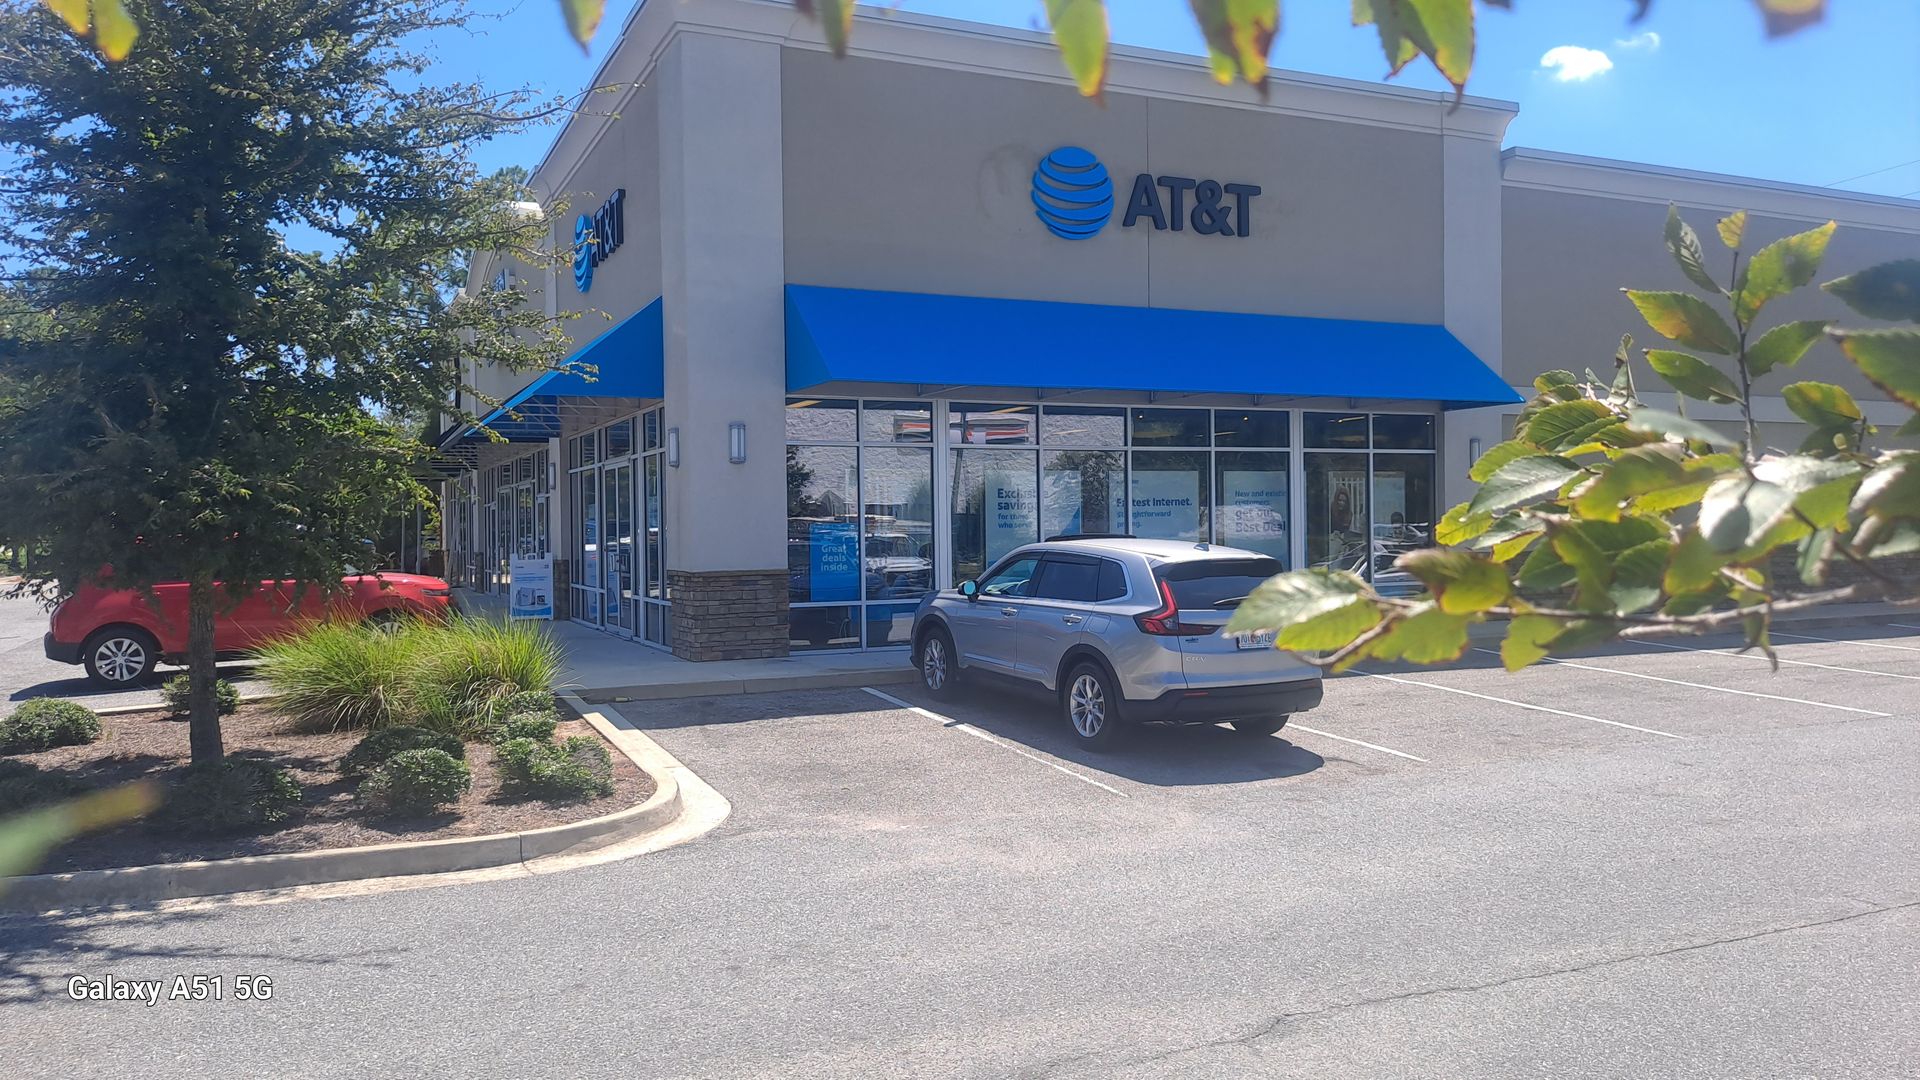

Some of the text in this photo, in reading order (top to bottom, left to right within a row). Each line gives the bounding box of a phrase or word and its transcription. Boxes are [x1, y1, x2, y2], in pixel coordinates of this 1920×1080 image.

[1122, 173, 1261, 237] AT&T
[591, 188, 626, 268] AT&T
[997, 487, 1049, 499] Exclusie
[1116, 497, 1192, 507] Fatest Internet.
[998, 513, 1009, 521] for
[821, 544, 847, 553] Great
[822, 553, 847, 562] deals
[820, 562, 848, 572] inside
